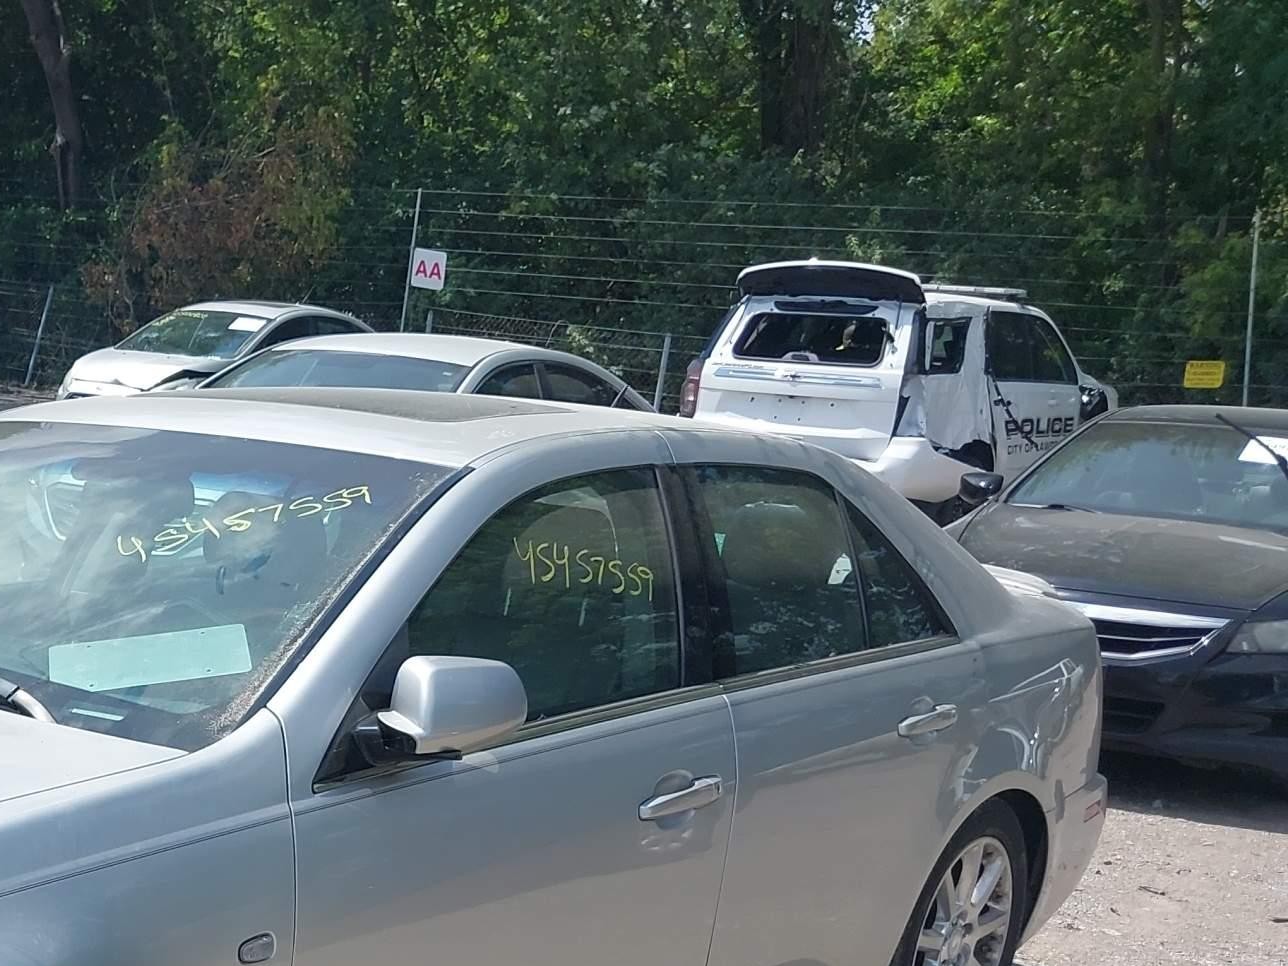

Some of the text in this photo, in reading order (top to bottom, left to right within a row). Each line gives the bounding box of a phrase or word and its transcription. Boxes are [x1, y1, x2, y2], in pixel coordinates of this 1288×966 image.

[415, 260, 441, 280] AA
[1005, 417, 1074, 437] POLICE
[116, 486, 372, 563] 45457559
[513, 536, 654, 602] 45457559
